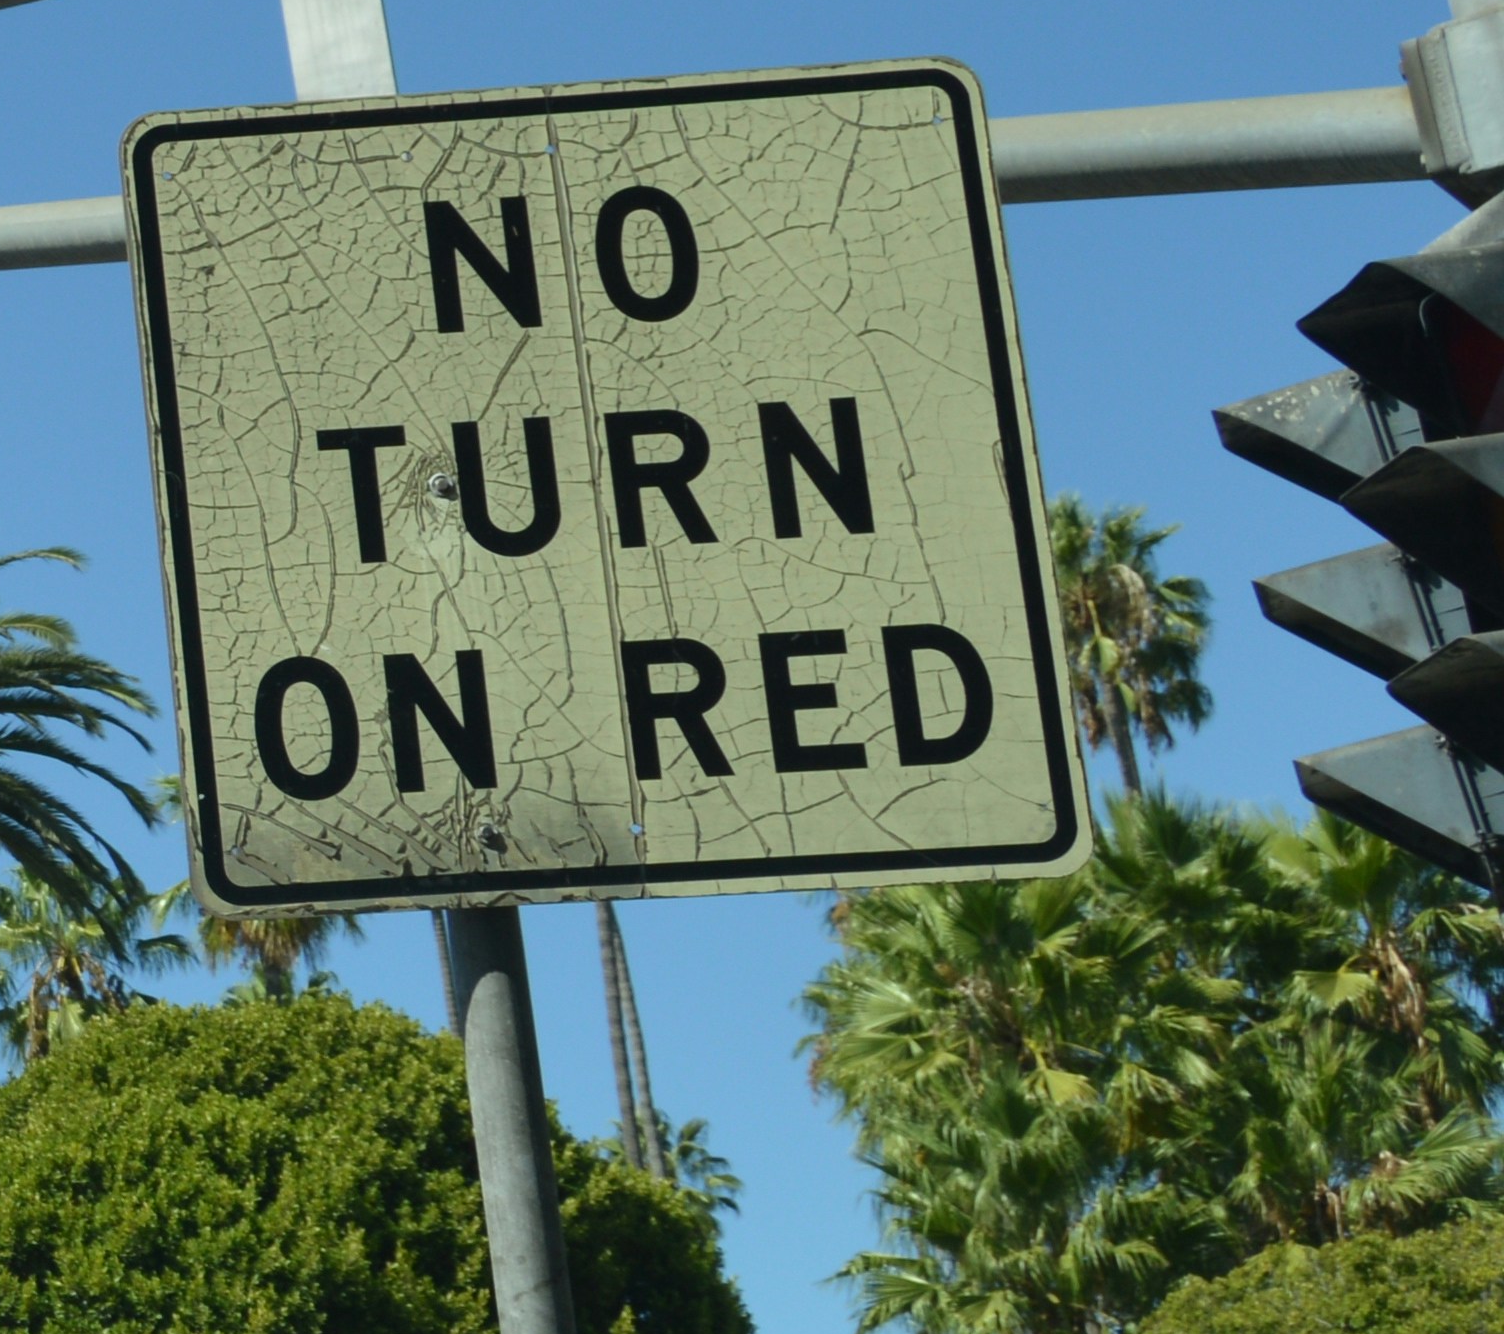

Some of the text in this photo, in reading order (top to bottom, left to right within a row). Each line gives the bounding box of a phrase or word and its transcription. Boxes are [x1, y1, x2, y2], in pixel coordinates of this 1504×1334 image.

[424, 185, 699, 332] NO
[316, 397, 874, 563] TURN
[254, 648, 498, 800] ON
[622, 623, 994, 780] RED
